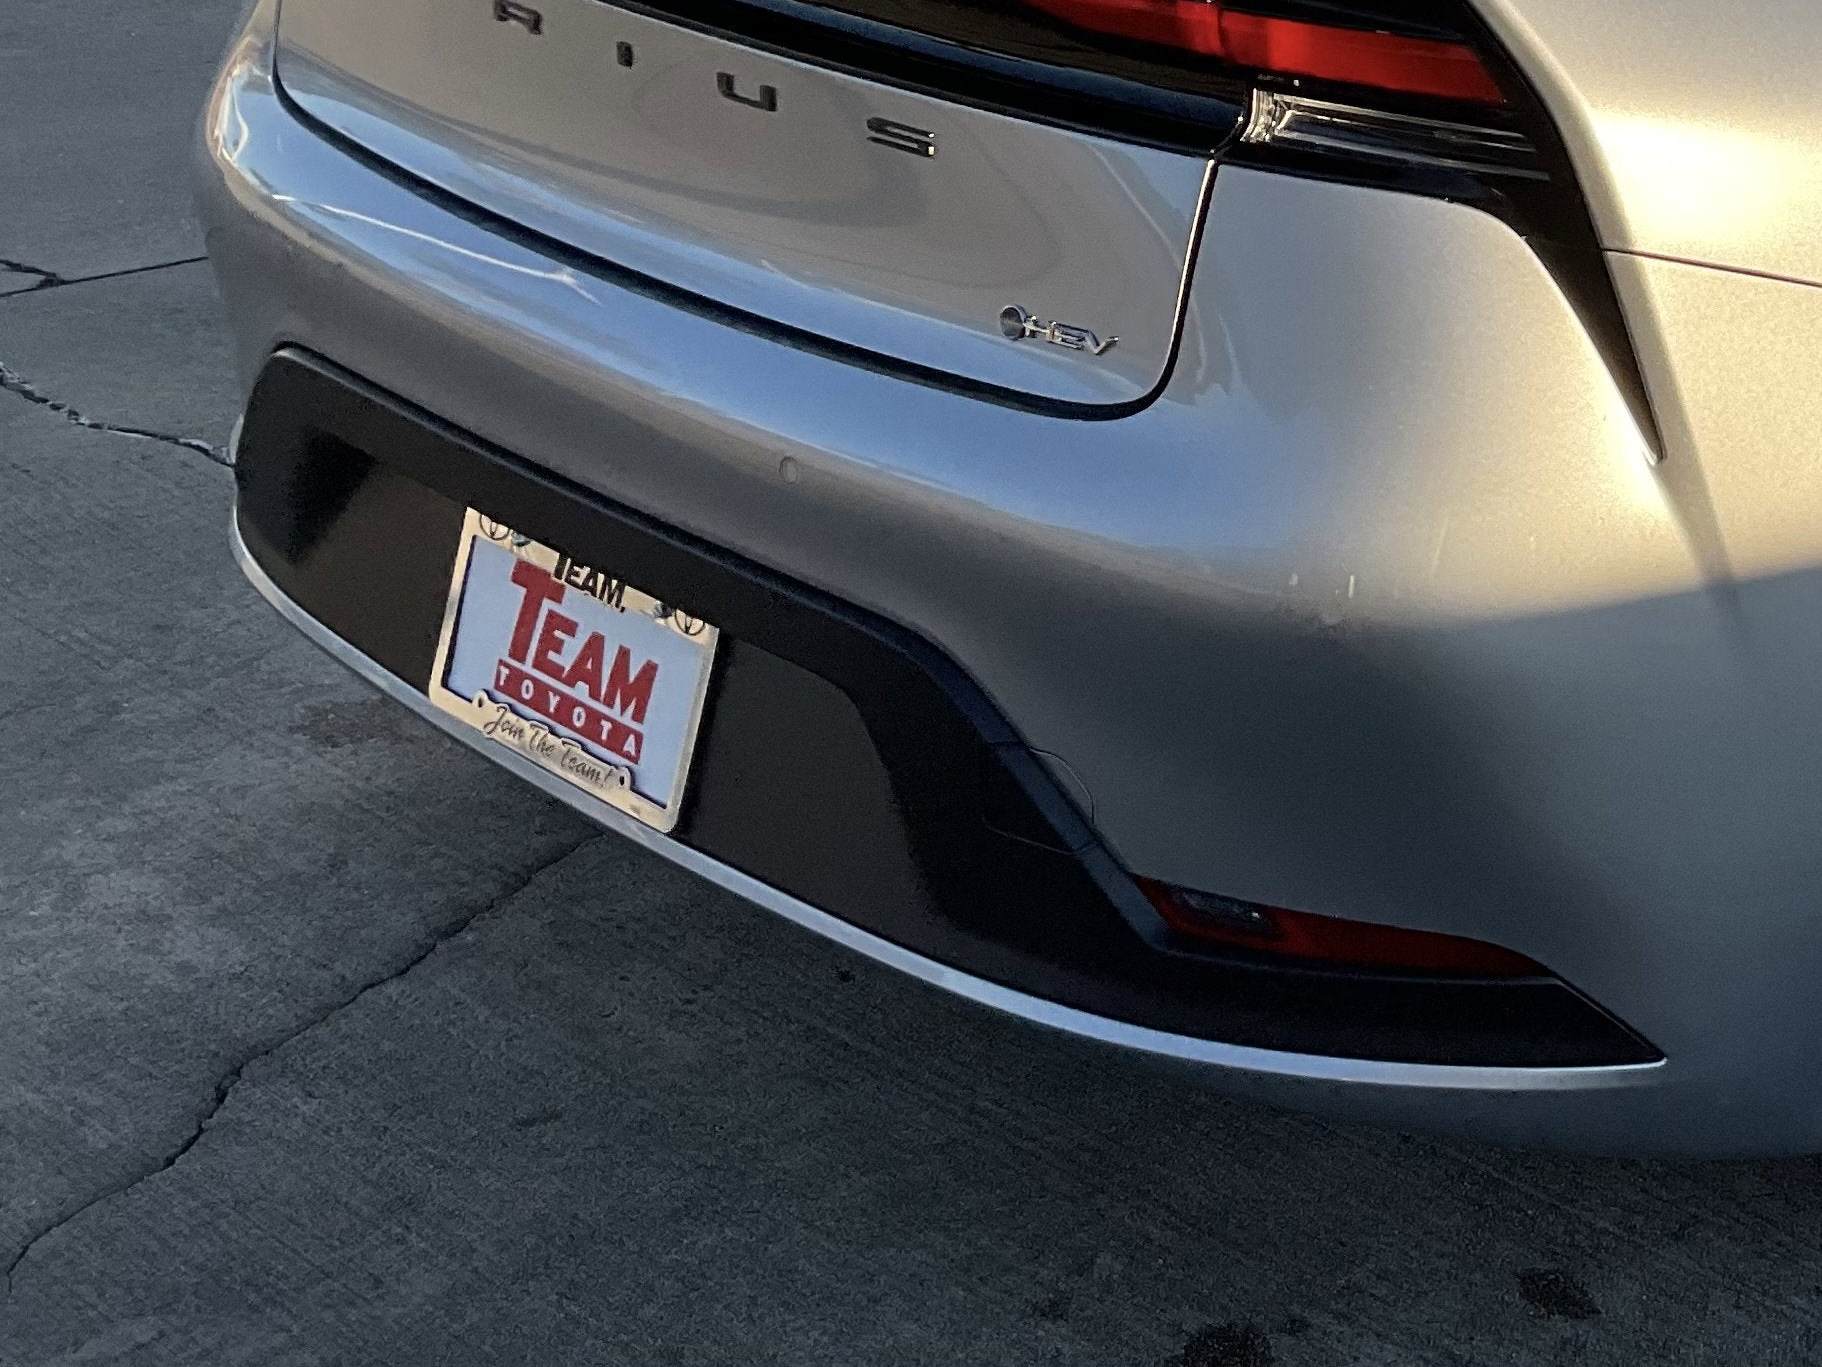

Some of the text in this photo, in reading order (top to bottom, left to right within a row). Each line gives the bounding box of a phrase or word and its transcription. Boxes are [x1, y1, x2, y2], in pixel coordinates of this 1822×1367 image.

[508, 558, 659, 725] TEAM
[483, 705, 615, 787] Join The Team!
[499, 665, 637, 758] TOYOTA
